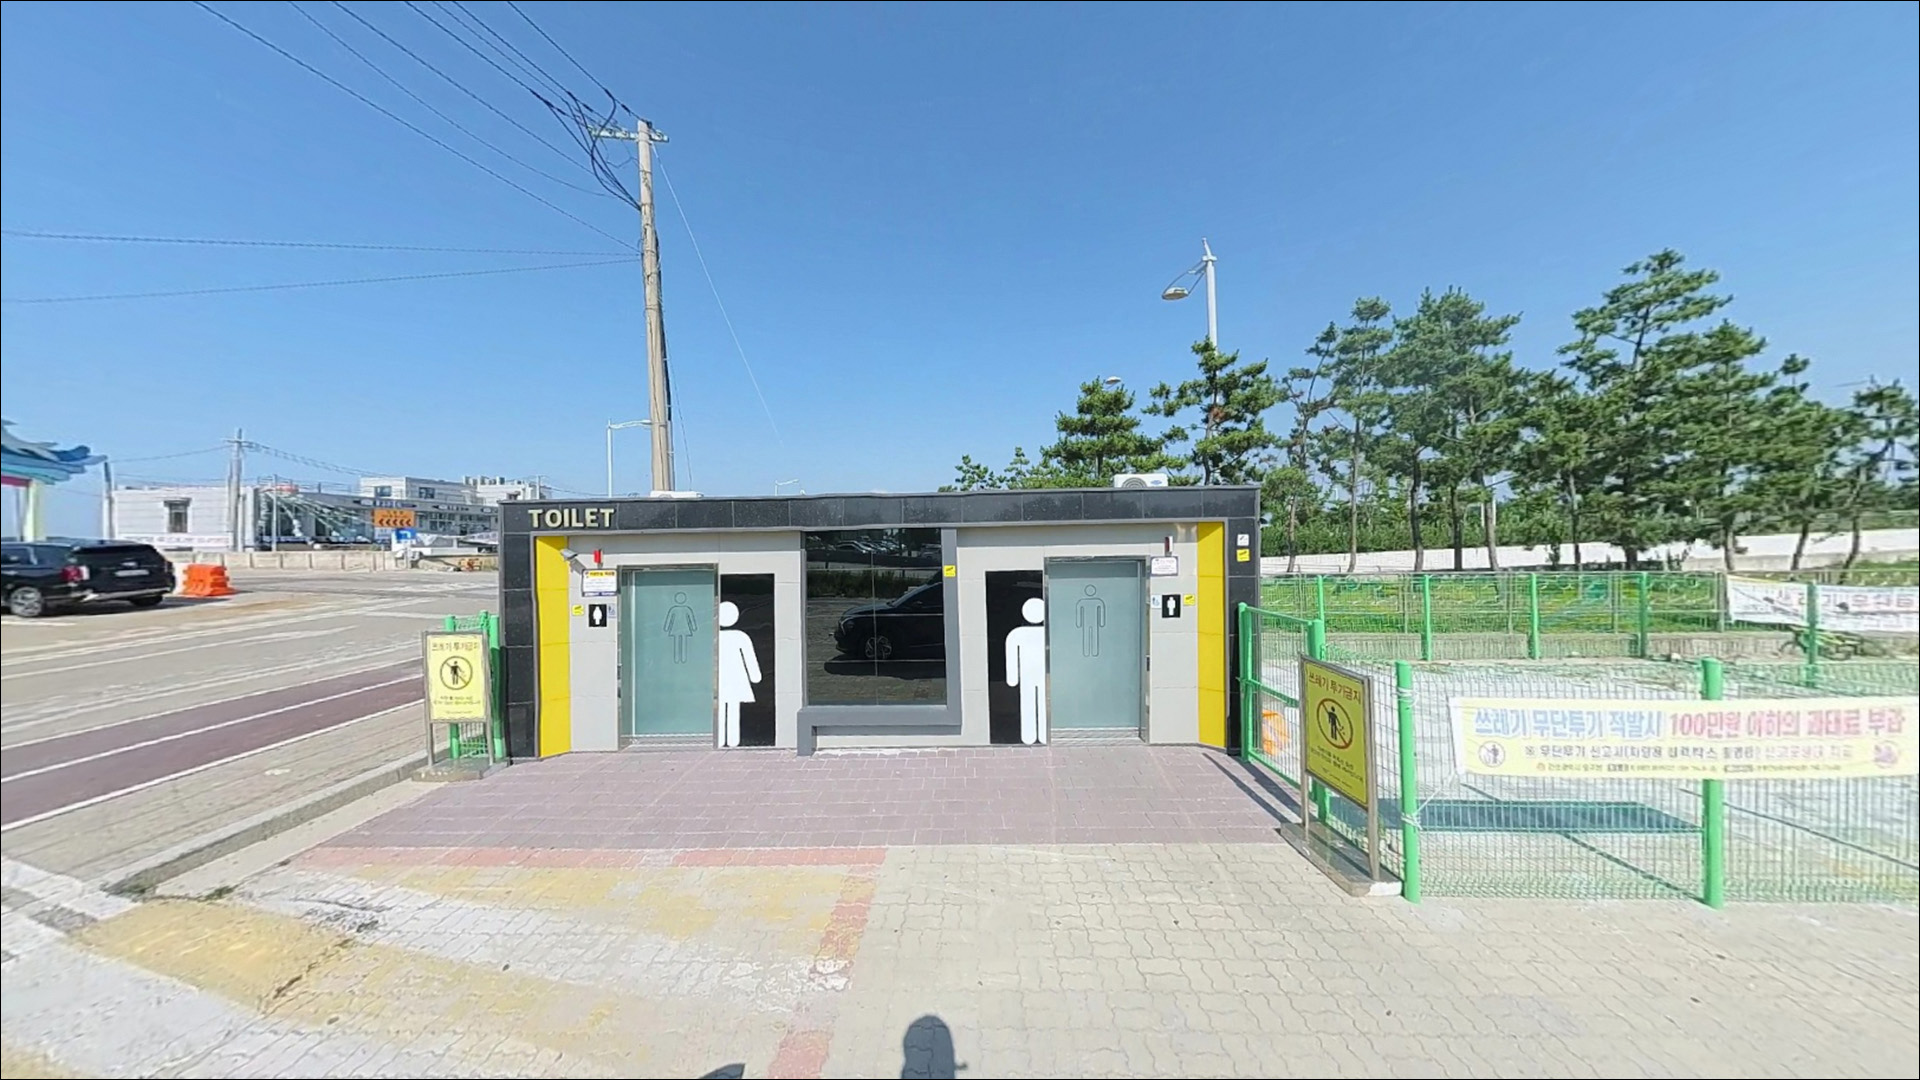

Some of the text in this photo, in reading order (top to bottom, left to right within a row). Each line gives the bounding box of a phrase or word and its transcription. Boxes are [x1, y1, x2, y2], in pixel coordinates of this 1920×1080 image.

[528, 508, 615, 529] TOILET
[1308, 671, 1361, 704] 쓰레기 투기금지
[1474, 707, 1527, 735] 쓰레기
[1532, 709, 1603, 738] 무단투기
[1608, 709, 1662, 738] 적발시
[1669, 710, 1741, 738] 100만원
[1746, 709, 1800, 737] 이하의
[1539, 744, 1586, 759] 무단투기
